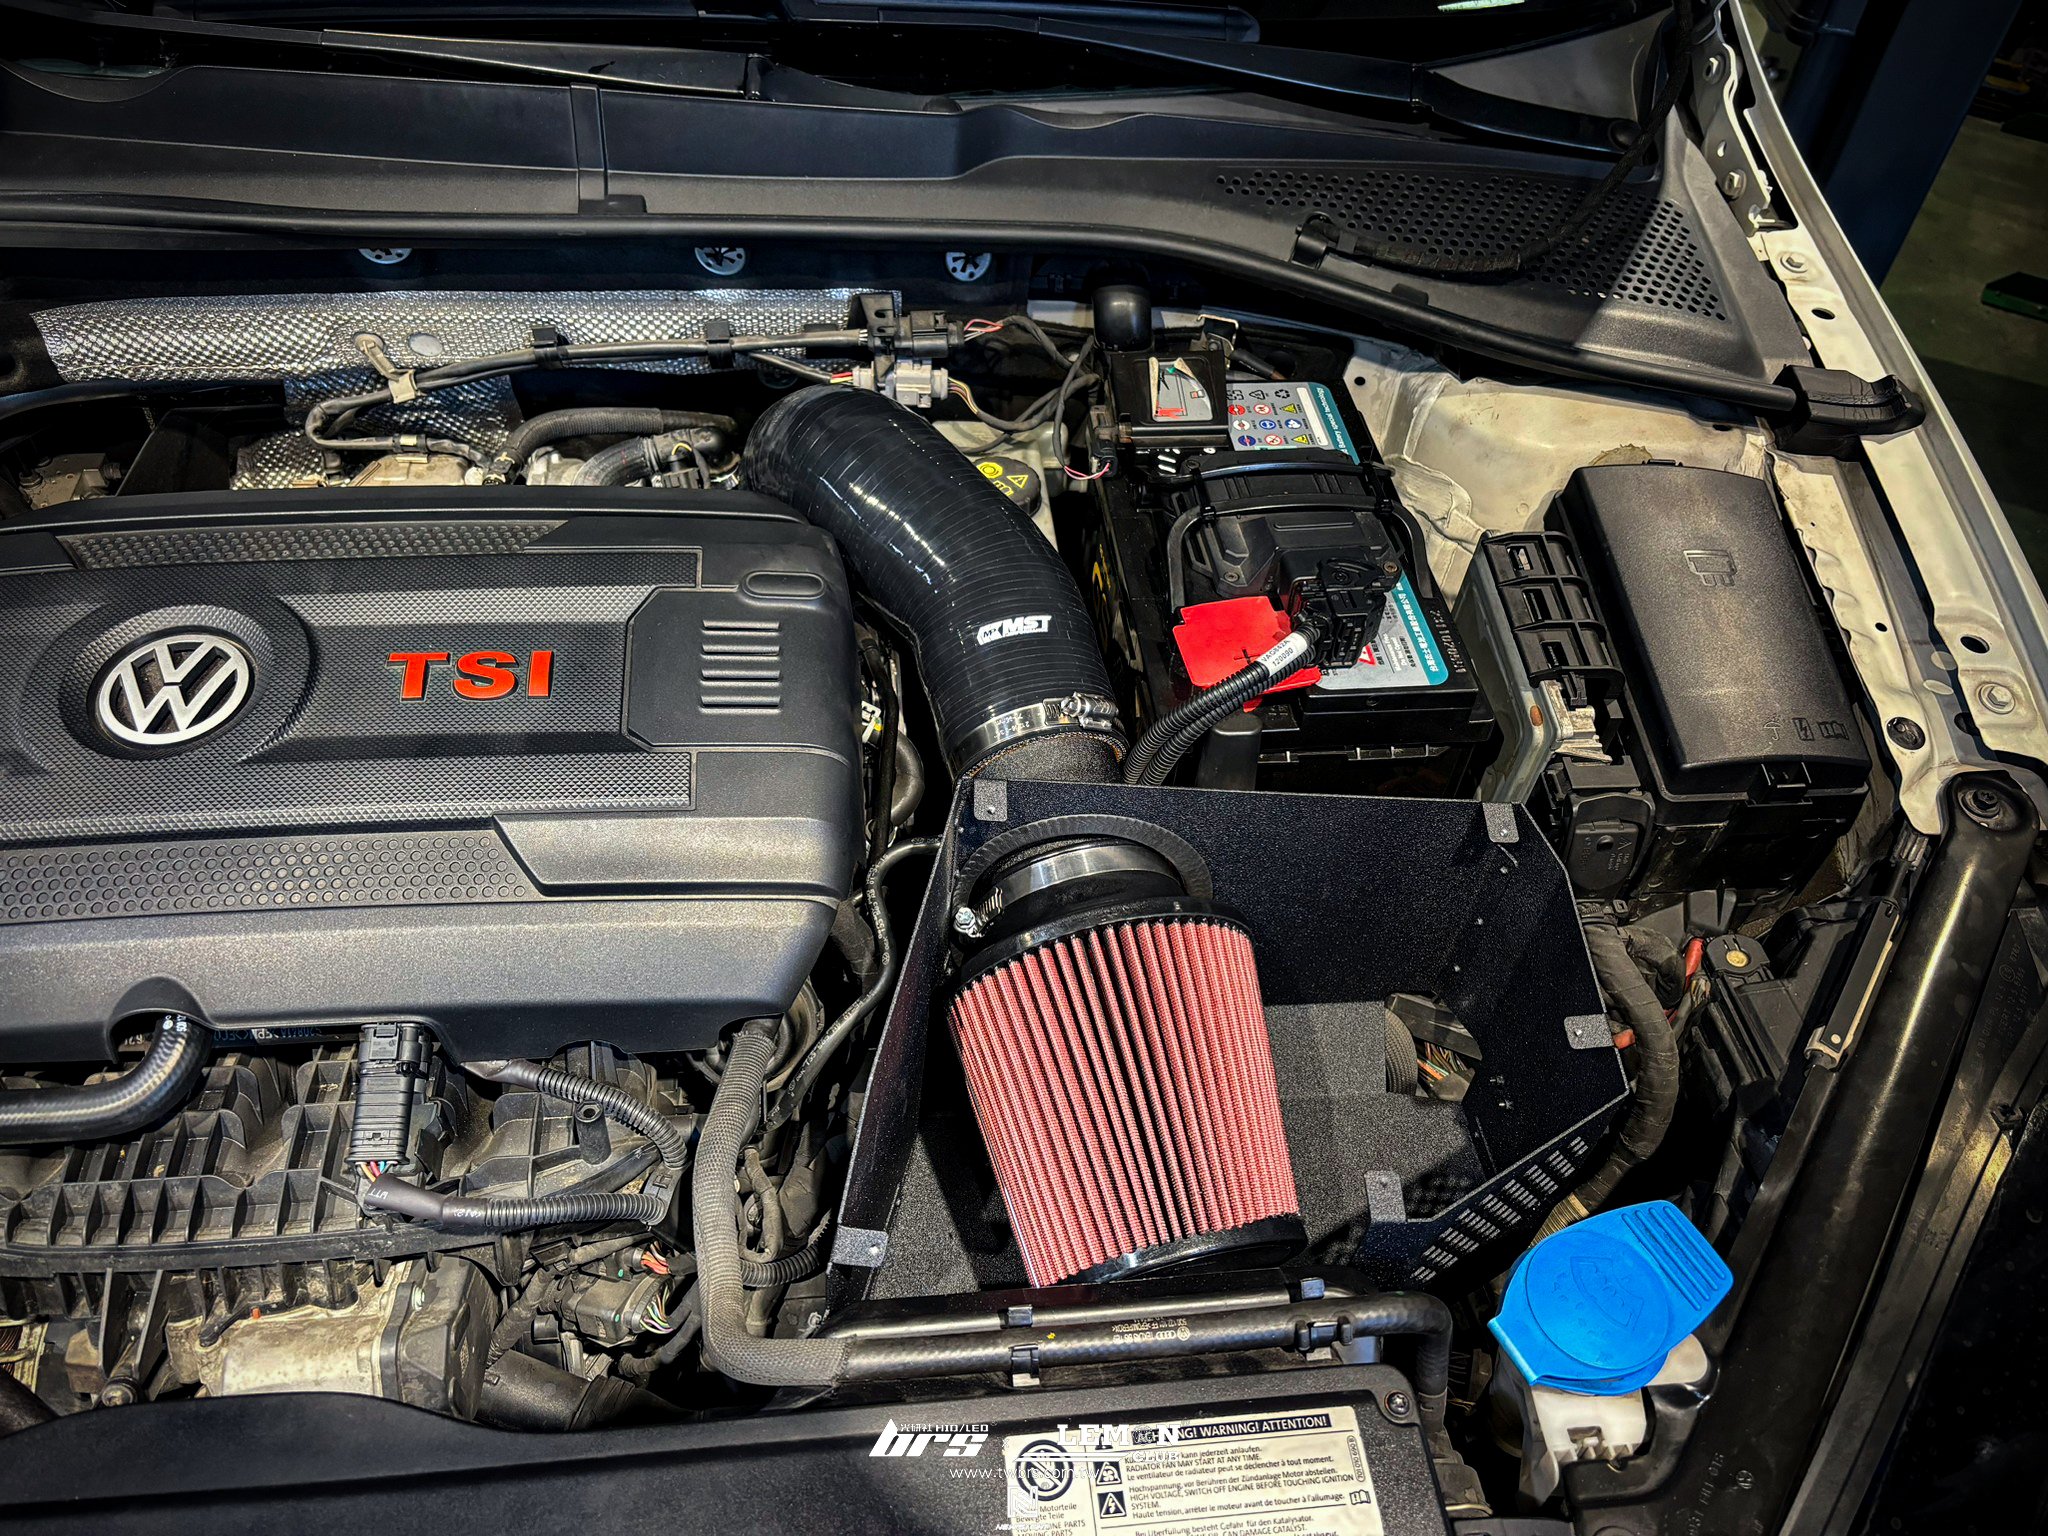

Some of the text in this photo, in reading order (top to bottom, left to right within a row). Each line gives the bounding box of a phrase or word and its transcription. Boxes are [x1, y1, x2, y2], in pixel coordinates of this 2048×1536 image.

[387, 650, 553, 699] TSI
[1136, 1416, 1326, 1442] ACHNG! WARNING! ATTENTION!
[1180, 1450, 1197, 1458] kann
[1199, 1447, 1228, 1458] jederzeit
[1231, 1444, 1262, 1453] anlaufen.
[1126, 1462, 1160, 1472] RADIATOR
[1177, 1459, 1193, 1467] MAY
[1194, 1457, 1214, 1465] START
[1136, 1470, 1173, 1479] ventilateur
[1184, 1466, 1216, 1475] radiateur
[1217, 1465, 1233, 1474] peut
[1302, 1455, 1333, 1464] moment.
[1128, 1481, 1183, 1494] Hochspannung,
[1196, 1477, 1227, 1486] Berühren
[1241, 1472, 1281, 1483] Zündanlage
[1282, 1469, 1303, 1478] Motor
[1304, 1466, 1337, 1475] abstellen.
[1130, 1493, 1149, 1501] HIGH
[1184, 1487, 1212, 1496] SWITCH
[1213, 1485, 1226, 1493] OFF
[1227, 1483, 1253, 1492] ENGINE
[1255, 1480, 1281, 1489] BEFORE
[1283, 1476, 1320, 1486] TOUCHING
[1321, 1473, 1353, 1482] IGNITION
[1039, 1502, 1077, 1512] Motorteile
[1155, 1508, 1183, 1517] tension,
[1216, 1502, 1242, 1510] moteur
[1274, 1496, 1300, 1504] toucher
[1064, 1519, 1085, 1528] PARTS
[1191, 1523, 1218, 1532] besteht
[1219, 1520, 1243, 1529] Gefahr
[1258, 1518, 1272, 1526] den
[1273, 1514, 1313, 1526] Katalysator.
[1272, 1523, 1307, 1533] CATALYST.
